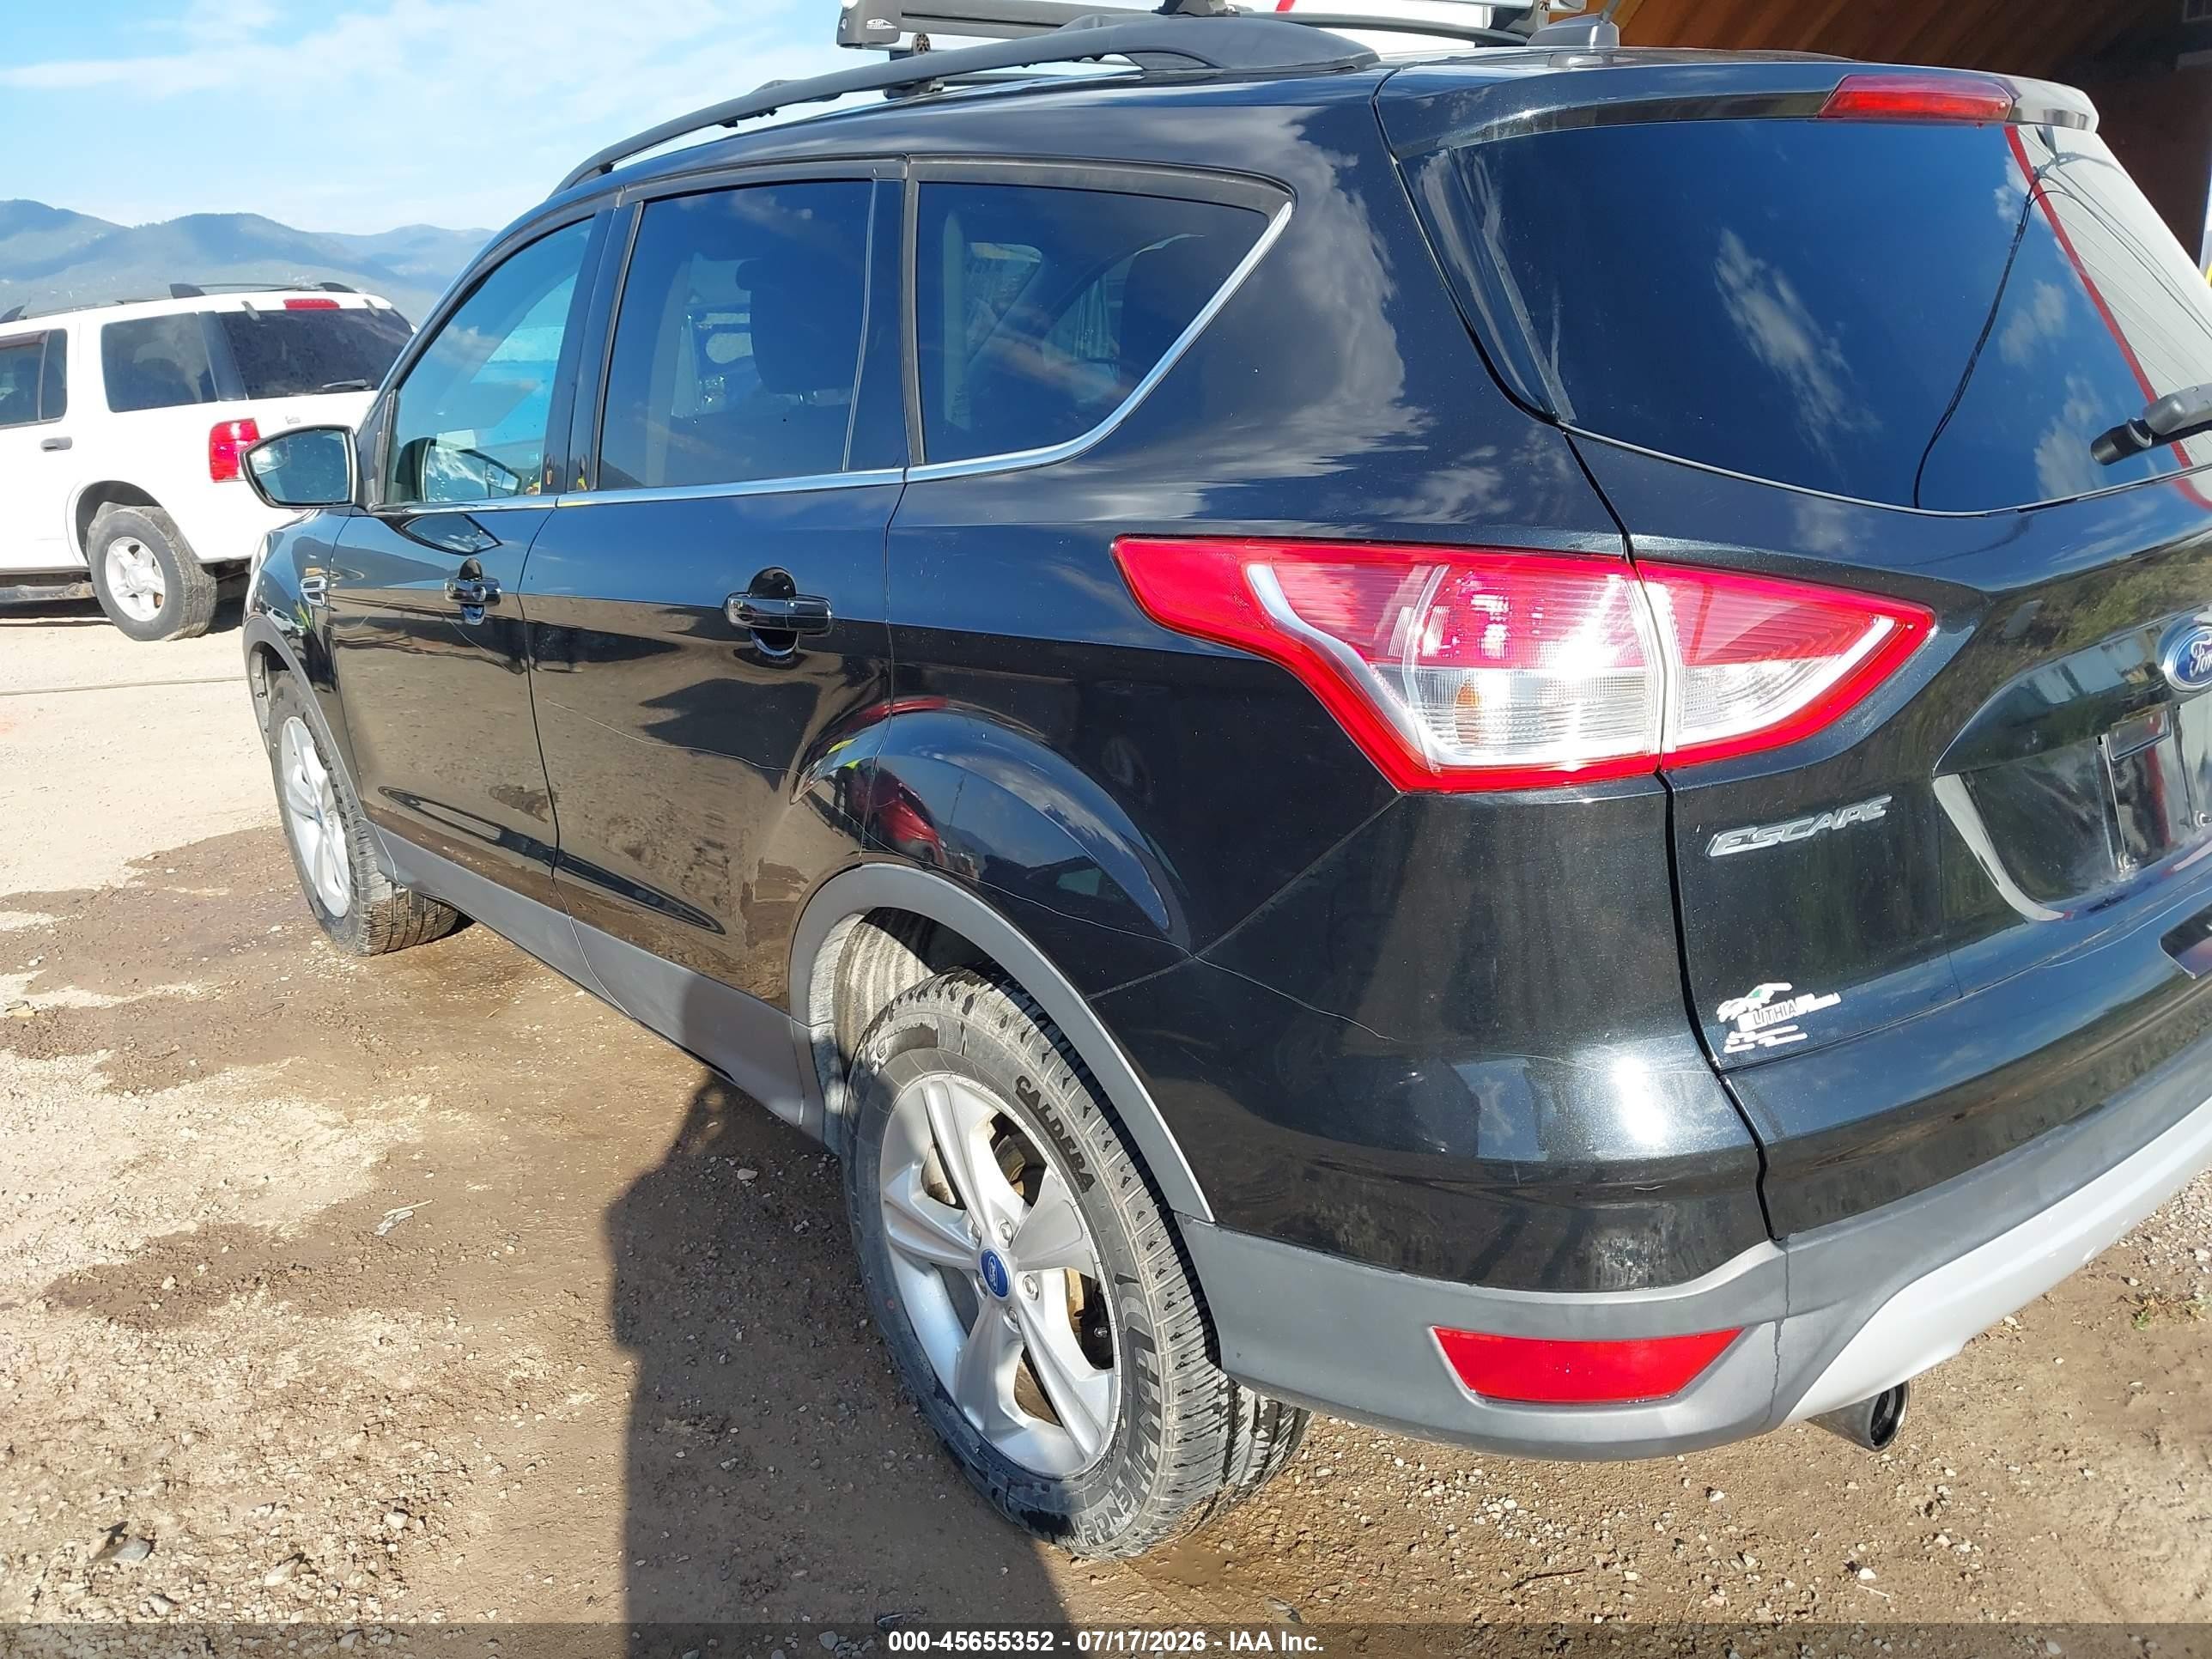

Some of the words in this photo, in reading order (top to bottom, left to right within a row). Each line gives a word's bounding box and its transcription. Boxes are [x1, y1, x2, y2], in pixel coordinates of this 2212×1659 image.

[2189, 637, 2212, 678] For
[1705, 795, 1893, 858] ESCAPE
[1753, 1000, 1797, 1025] LITHIA
[1016, 1075, 1096, 1193] CALDERA
[1075, 1345, 1157, 1540] CONFIDENCE
